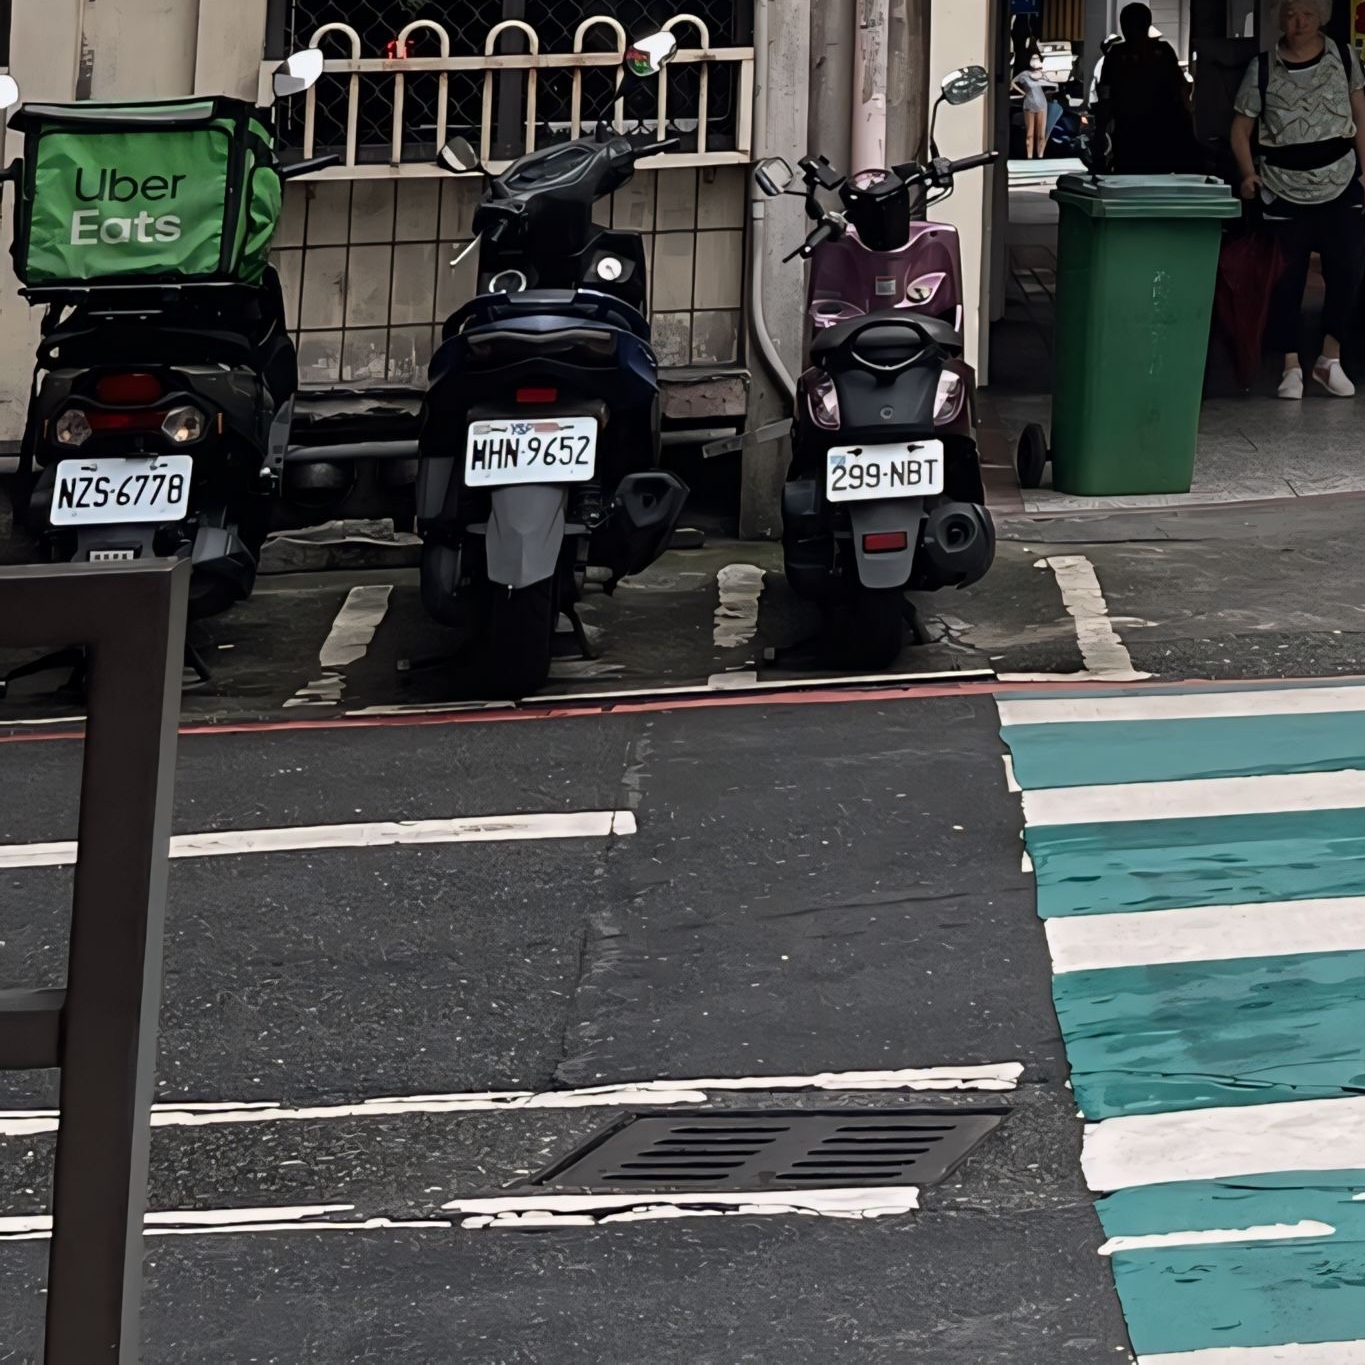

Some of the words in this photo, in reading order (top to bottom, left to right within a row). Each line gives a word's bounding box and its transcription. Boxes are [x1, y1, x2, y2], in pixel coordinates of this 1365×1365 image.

[75, 167, 187, 203] Uber
[70, 208, 182, 246] Eats
[58, 473, 185, 510] NZS-6778
[831, 458, 939, 492] 299-NBT
